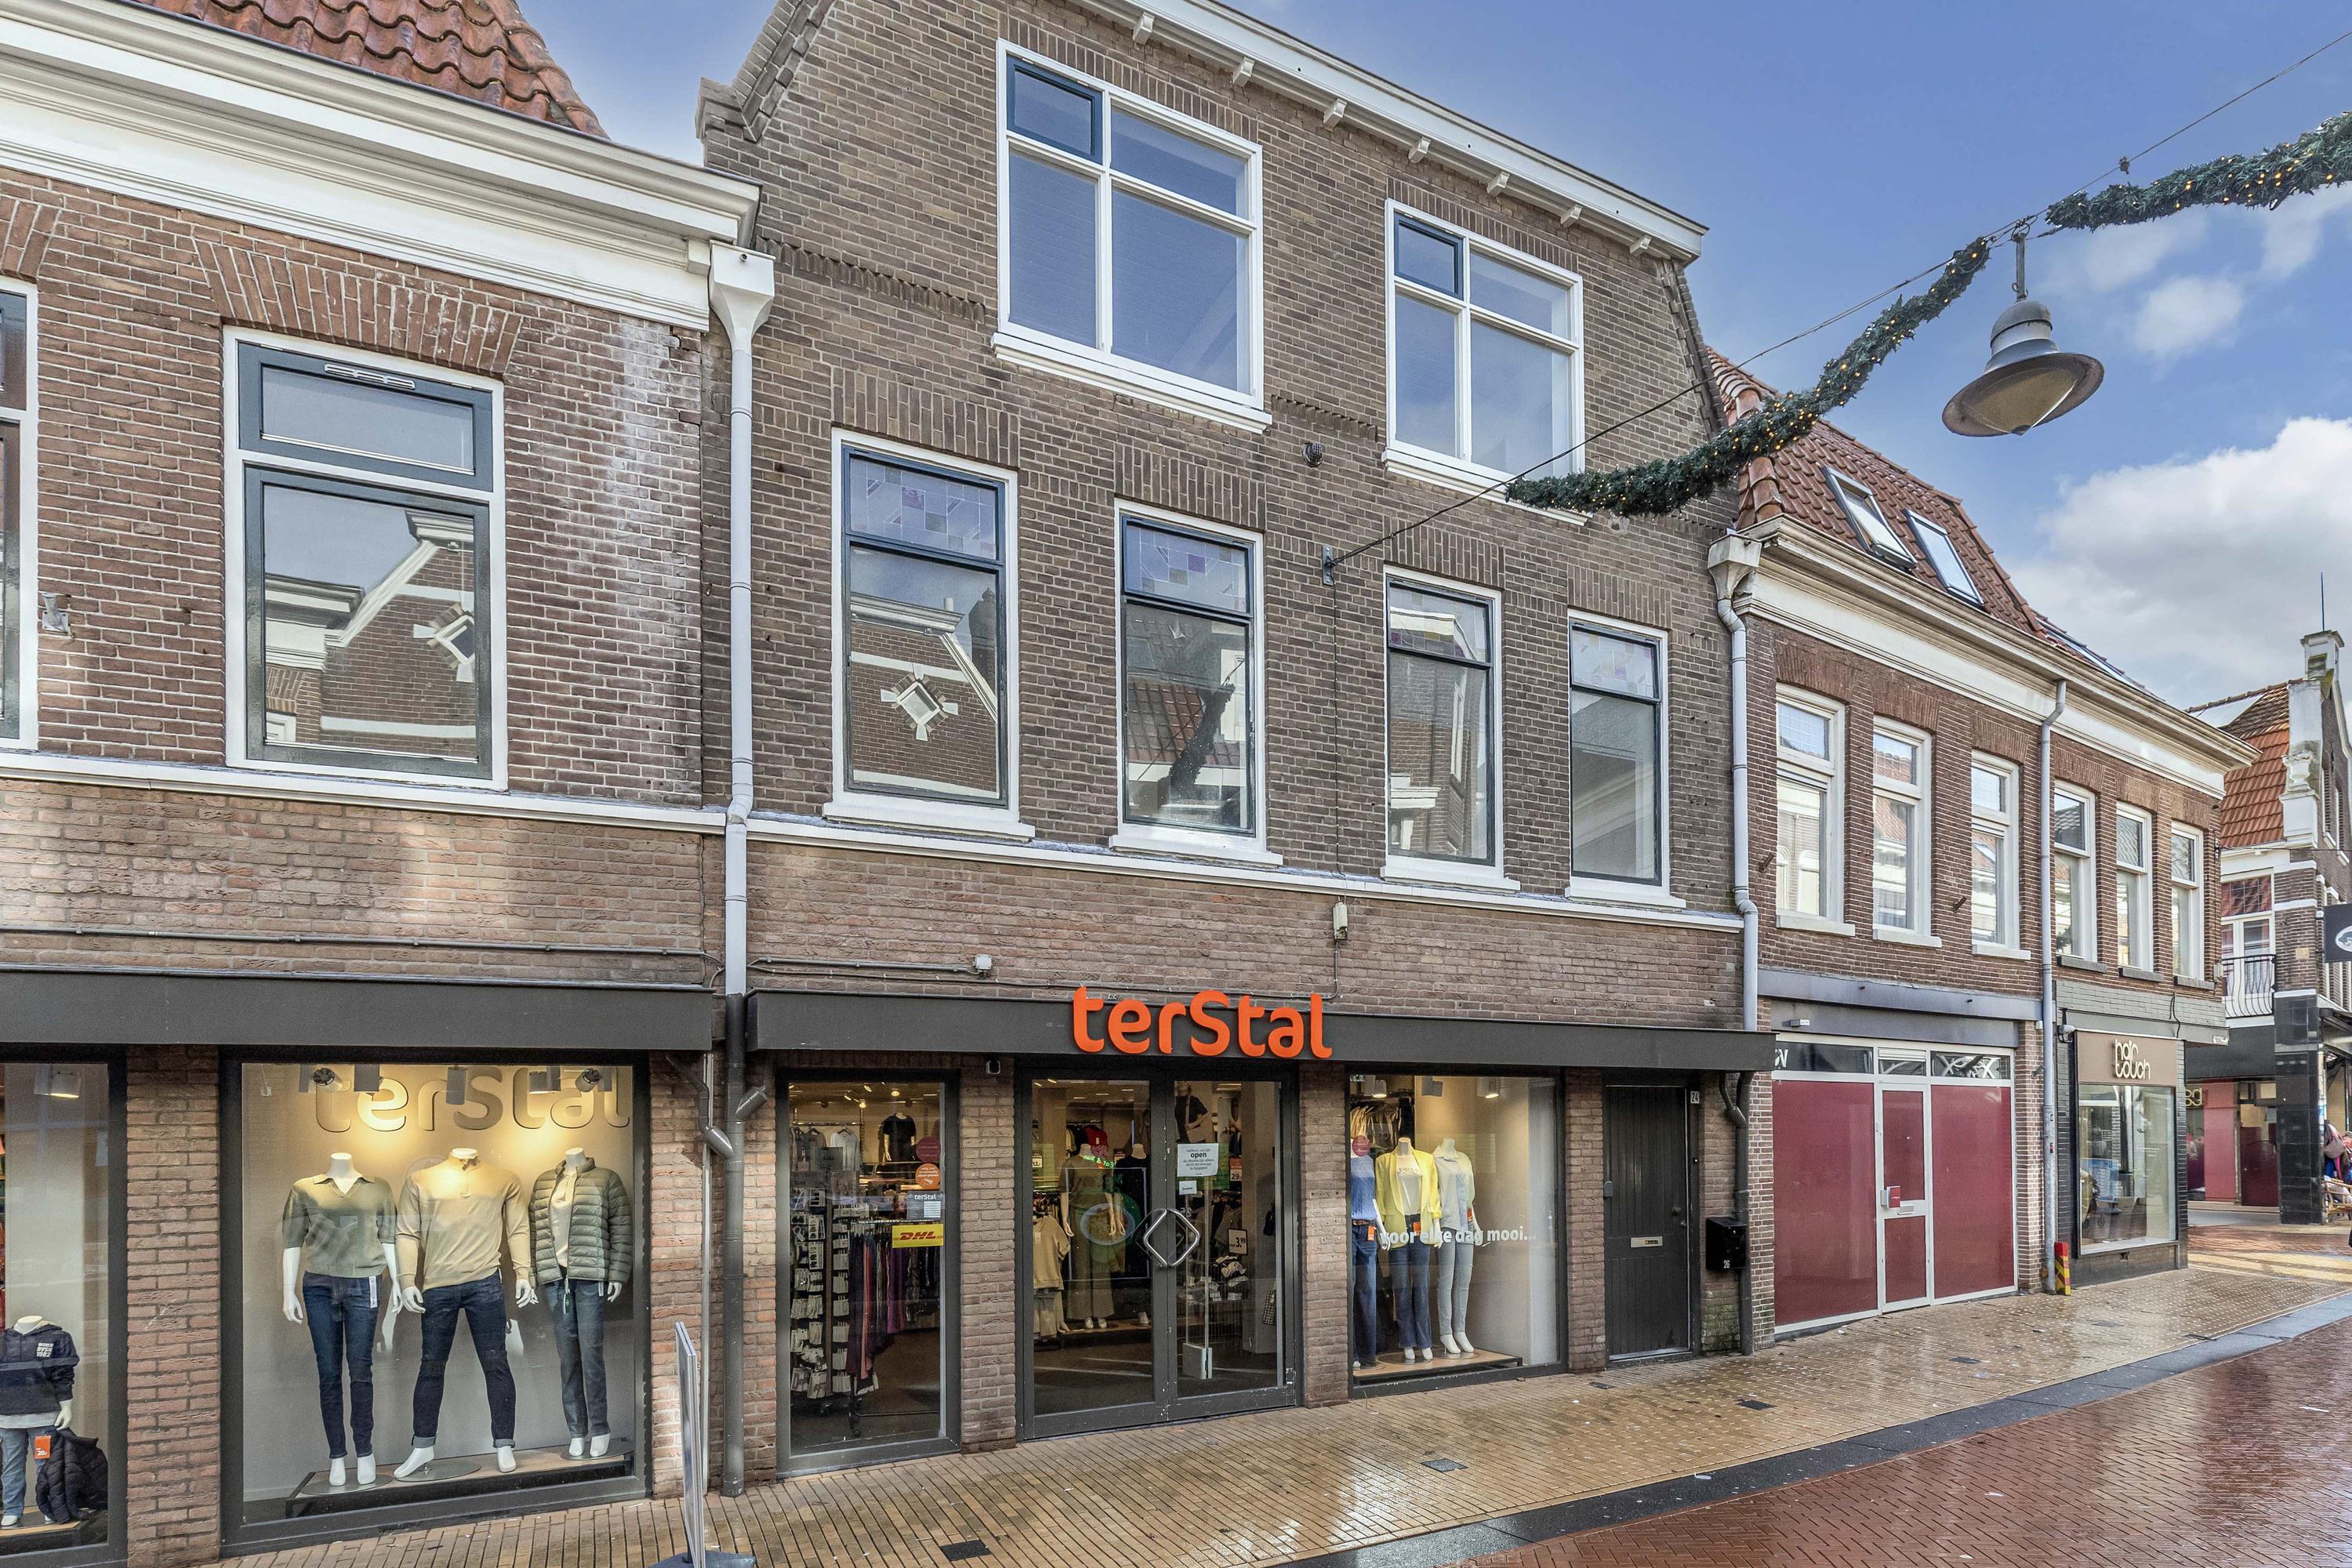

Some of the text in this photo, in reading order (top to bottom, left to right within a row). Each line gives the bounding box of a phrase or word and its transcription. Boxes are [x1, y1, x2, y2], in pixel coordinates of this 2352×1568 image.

[1073, 985, 1332, 1058] terStal
[2114, 1039, 2139, 1060] hair
[2114, 1059, 2151, 1080] touch
[1691, 1092, 1699, 1103] 24
[900, 1231, 937, 1241] DHL
[1380, 1230, 1414, 1244] voor
[1421, 1225, 1452, 1244] elke
[1455, 1226, 1484, 1247] dag
[1723, 1260, 1730, 1269] 26
